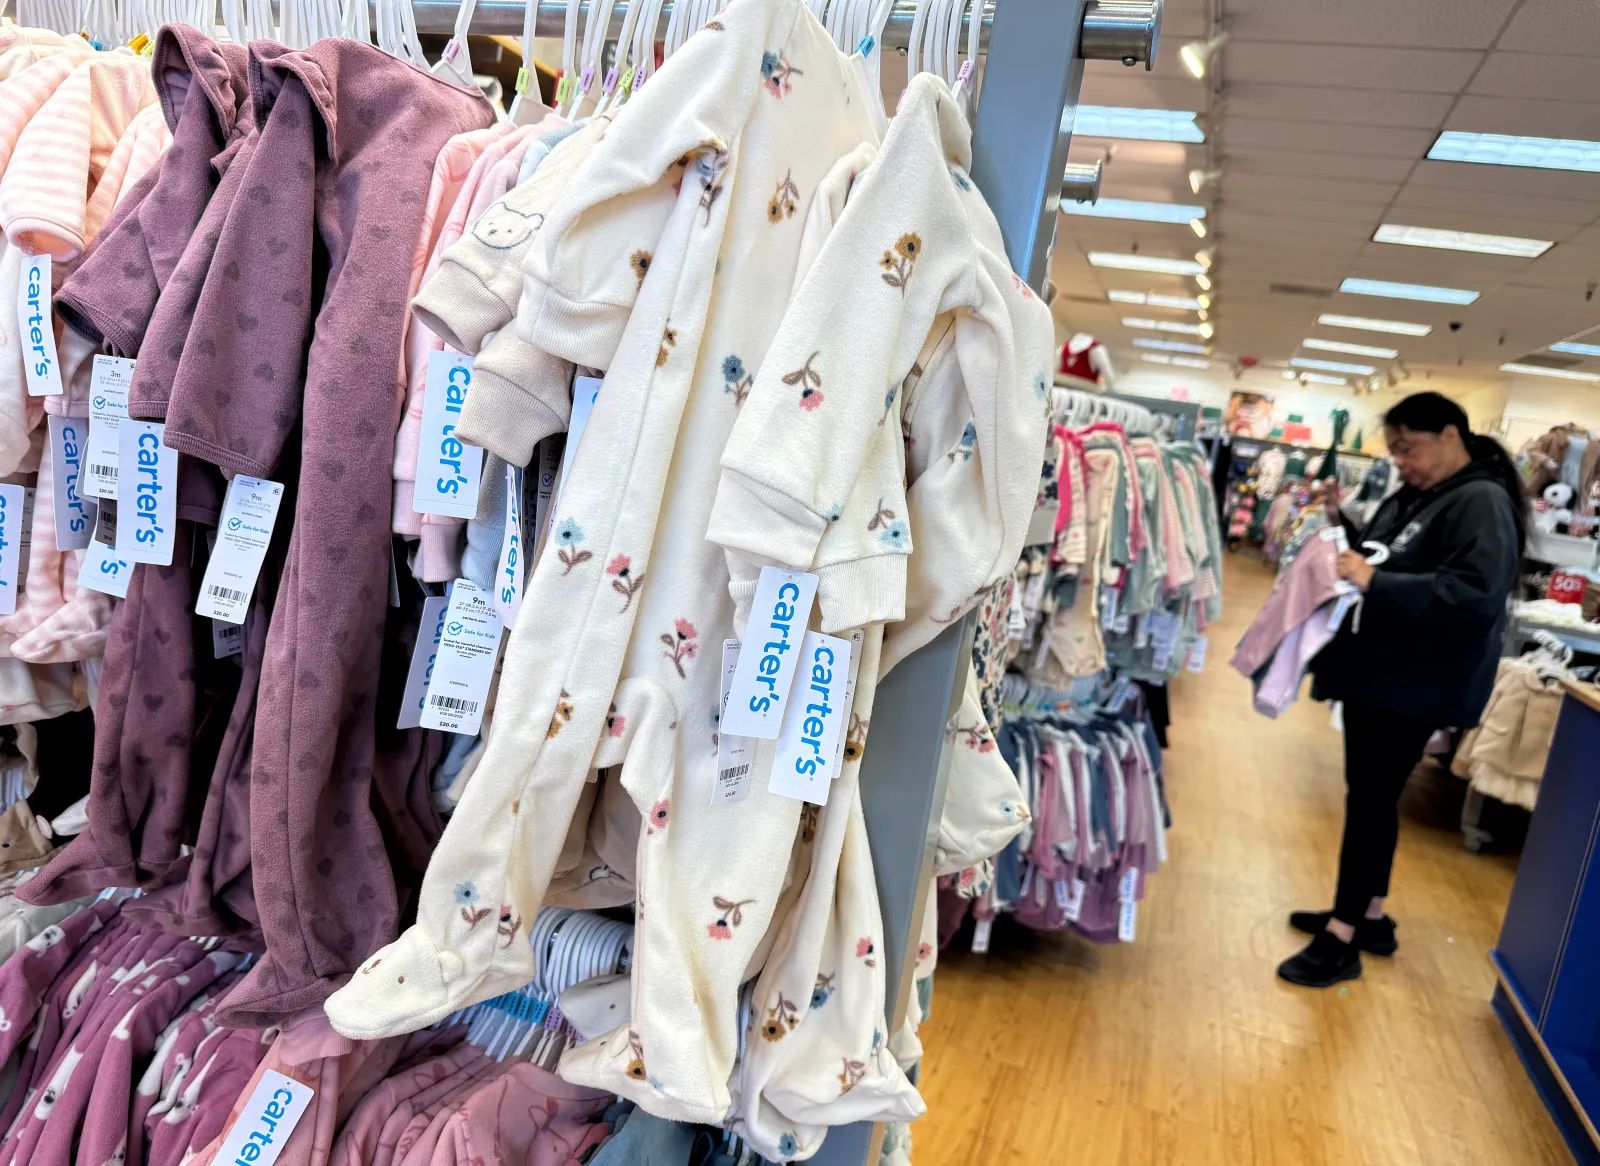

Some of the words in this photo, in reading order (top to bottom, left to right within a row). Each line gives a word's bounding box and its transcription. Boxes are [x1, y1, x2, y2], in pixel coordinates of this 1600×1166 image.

[28, 266, 51, 377] carter's
[110, 370, 122, 378] 3m
[136, 433, 164, 543] carter's
[252, 493, 262, 501] 9m
[472, 596, 486, 606] 9m
[750, 583, 799, 712] carter's
[795, 648, 834, 776] carter's
